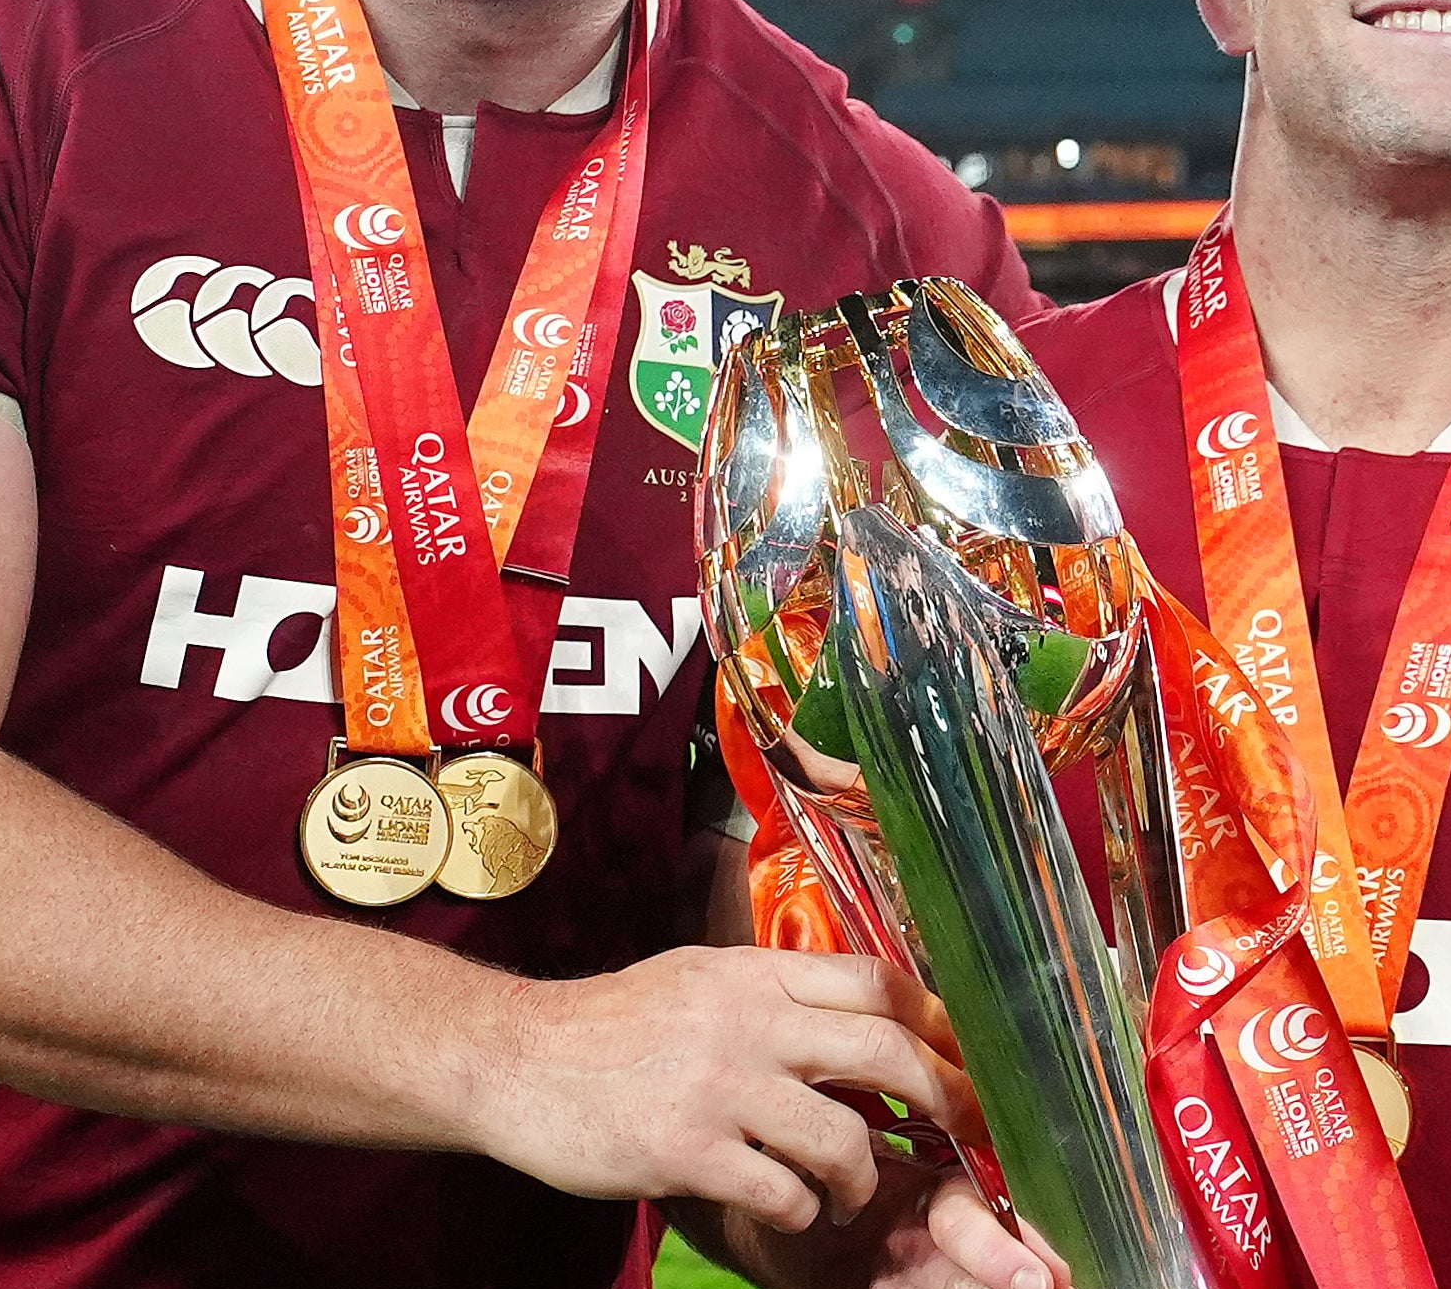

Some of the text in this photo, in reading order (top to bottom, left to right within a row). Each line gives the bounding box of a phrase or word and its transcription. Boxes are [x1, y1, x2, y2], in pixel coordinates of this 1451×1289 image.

[286, 12, 324, 95] AIRWAYS
[552, 180, 581, 241] AIRWAYS
[580, 158, 605, 241] QATAR
[362, 257, 387, 314] LIONS
[388, 253, 414, 310] QATAR
[1198, 222, 1227, 319] QATAR
[509, 350, 534, 396] LIONS
[533, 355, 556, 401] QATAR
[345, 448, 361, 498] QATAR
[411, 432, 467, 561] QATAR
[481, 470, 512, 529] QAT
[1218, 460, 1237, 510] LIONS
[1241, 452, 1263, 502] QATAR
[399, 467, 437, 565] AIRWAYS
[1062, 558, 1090, 585] LIO
[140, 565, 703, 715] HOEN
[360, 626, 395, 727] QATAR
[384, 625, 404, 699] AIRWAYS
[1248, 609, 1298, 726] QATAR
[1400, 642, 1426, 694] QATAR
[1192, 649, 1257, 727] TAR
[380, 795, 432, 810] QATAR
[1323, 900, 1347, 956] QATAR
[1373, 868, 1406, 968] AIRWAYS
[1279, 1079, 1319, 1156] LIONS
[1309, 1093, 1337, 1148] AIRWAYS
[1314, 1067, 1353, 1144] QATAR
[1174, 1096, 1272, 1257] QATAR
[1187, 1156, 1262, 1271] AIRWAYS
